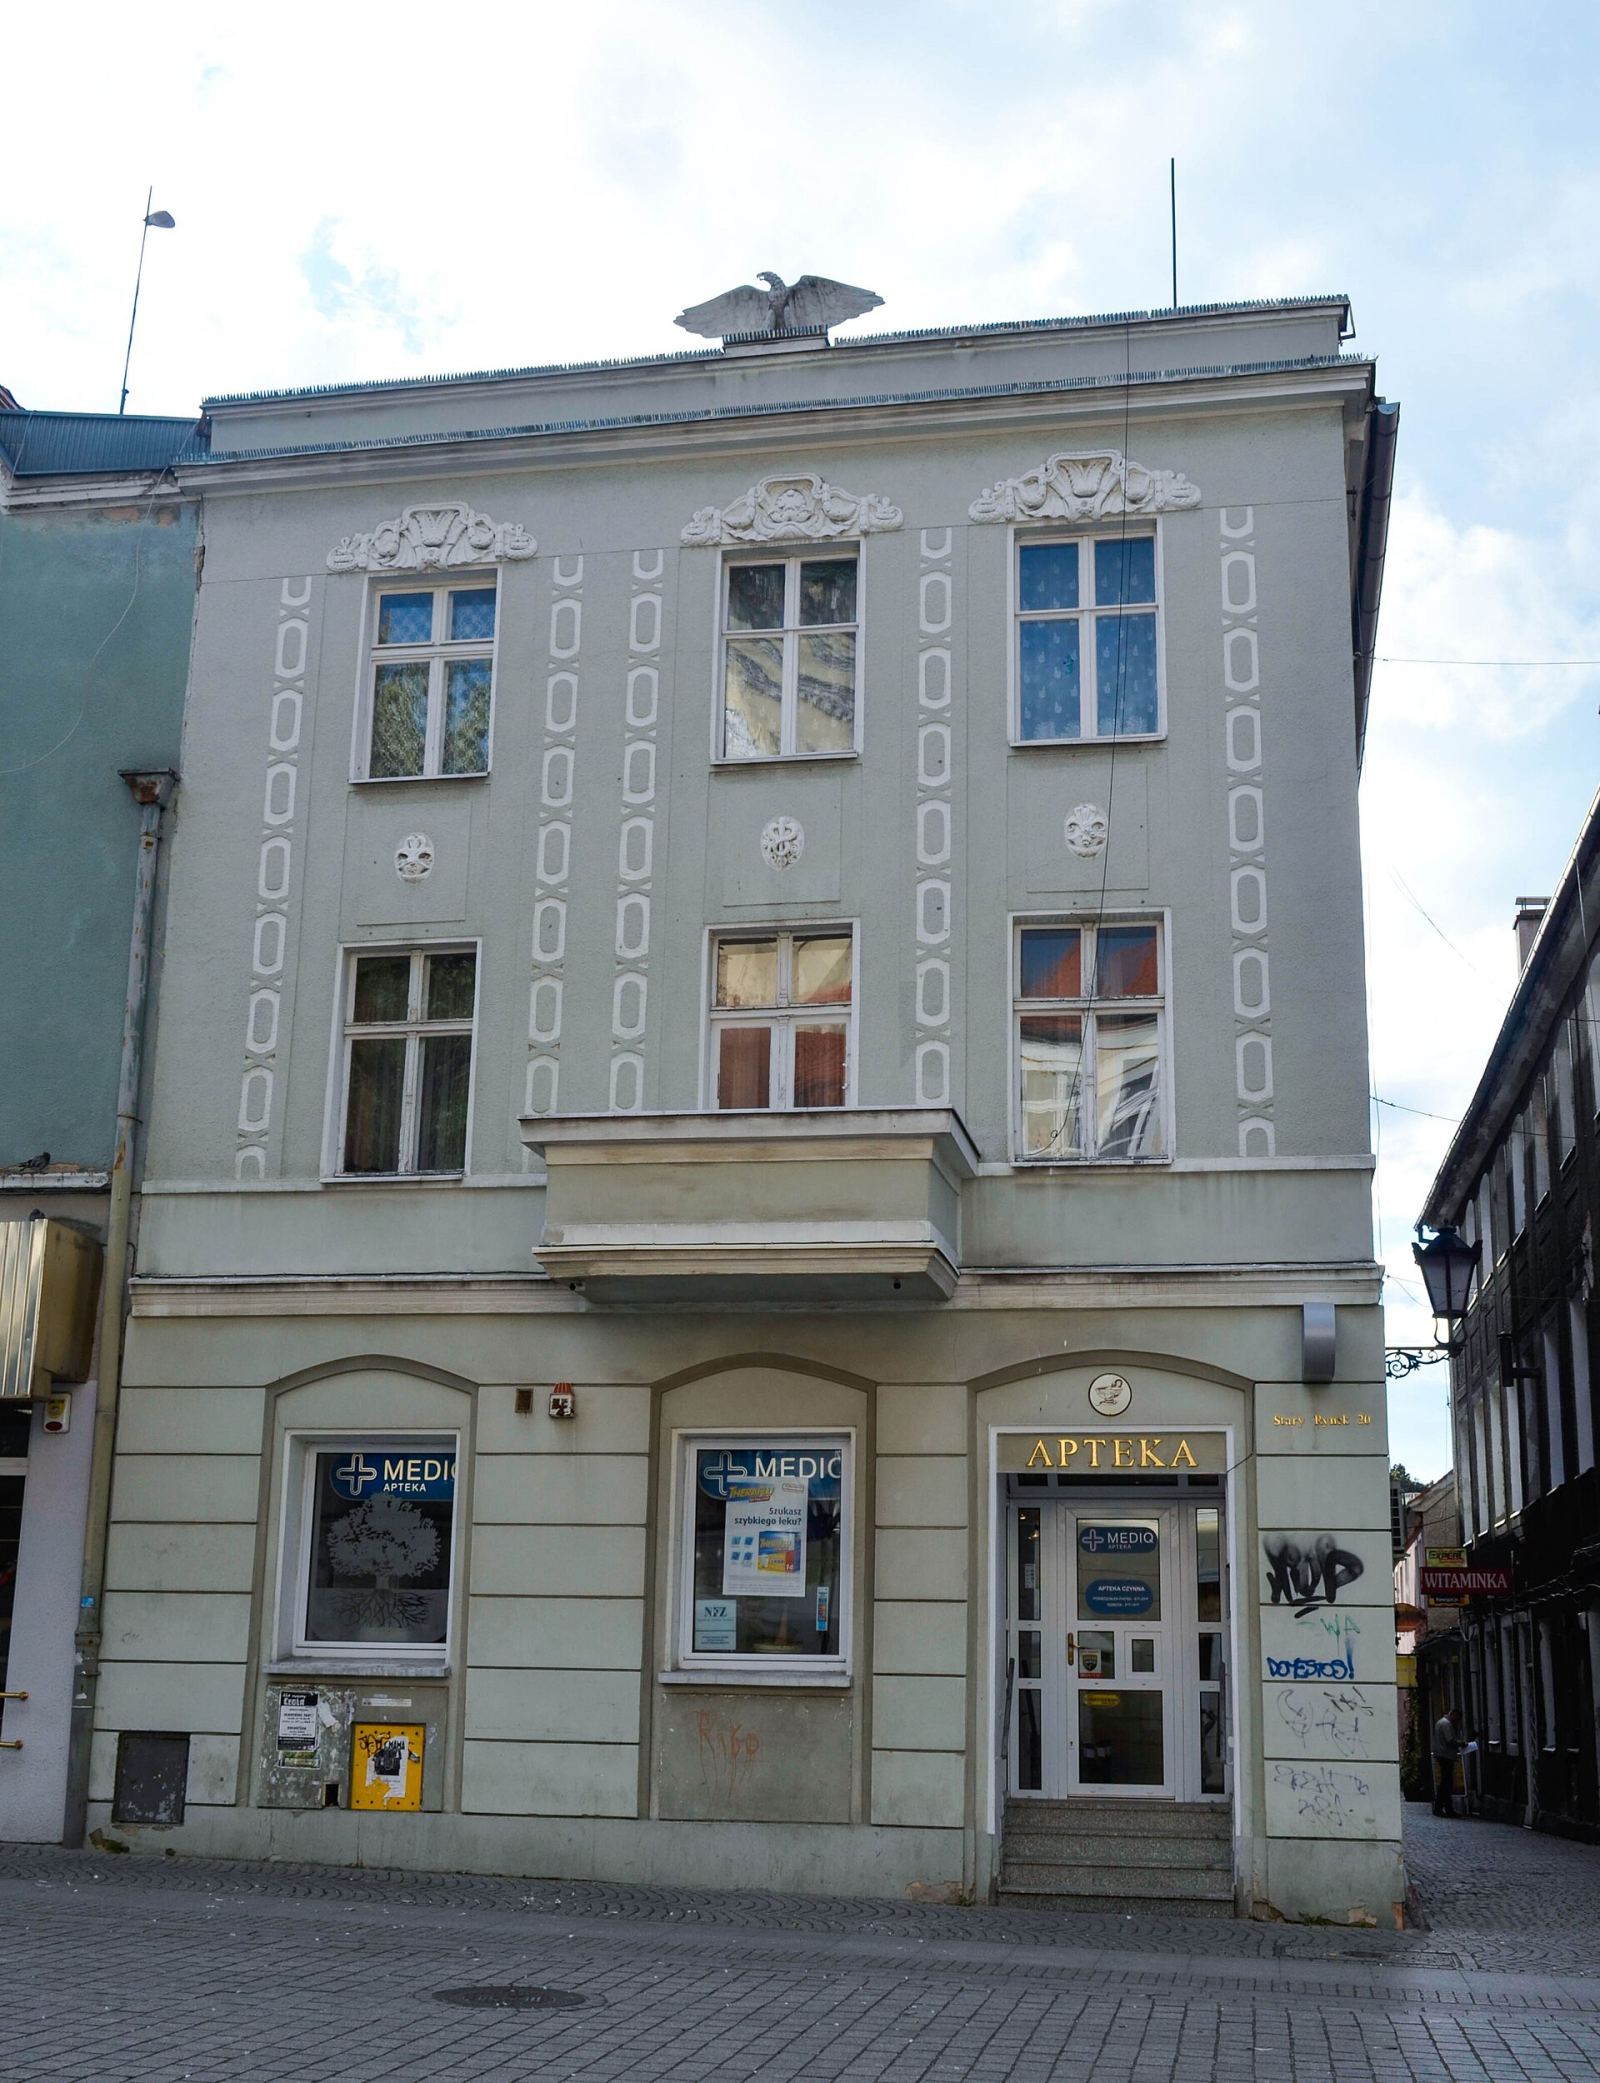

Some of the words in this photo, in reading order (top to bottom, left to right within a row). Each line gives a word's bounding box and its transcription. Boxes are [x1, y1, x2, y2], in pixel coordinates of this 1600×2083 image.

[1273, 1415, 1304, 1428] Stary
[1314, 1414, 1349, 1428] Rynek
[1358, 1414, 1371, 1425] 20
[1026, 1439, 1199, 1468] APTEKA
[383, 1459, 457, 1481] MEDI
[383, 1483, 426, 1492] APTEKA
[769, 1507, 802, 1516] Szukasz
[734, 1516, 776, 1526] szybkiego
[1107, 1532, 1154, 1544] MEDIQ
[1424, 1573, 1508, 1588] WITAMINKA
[704, 1606, 728, 1617] NFZ
